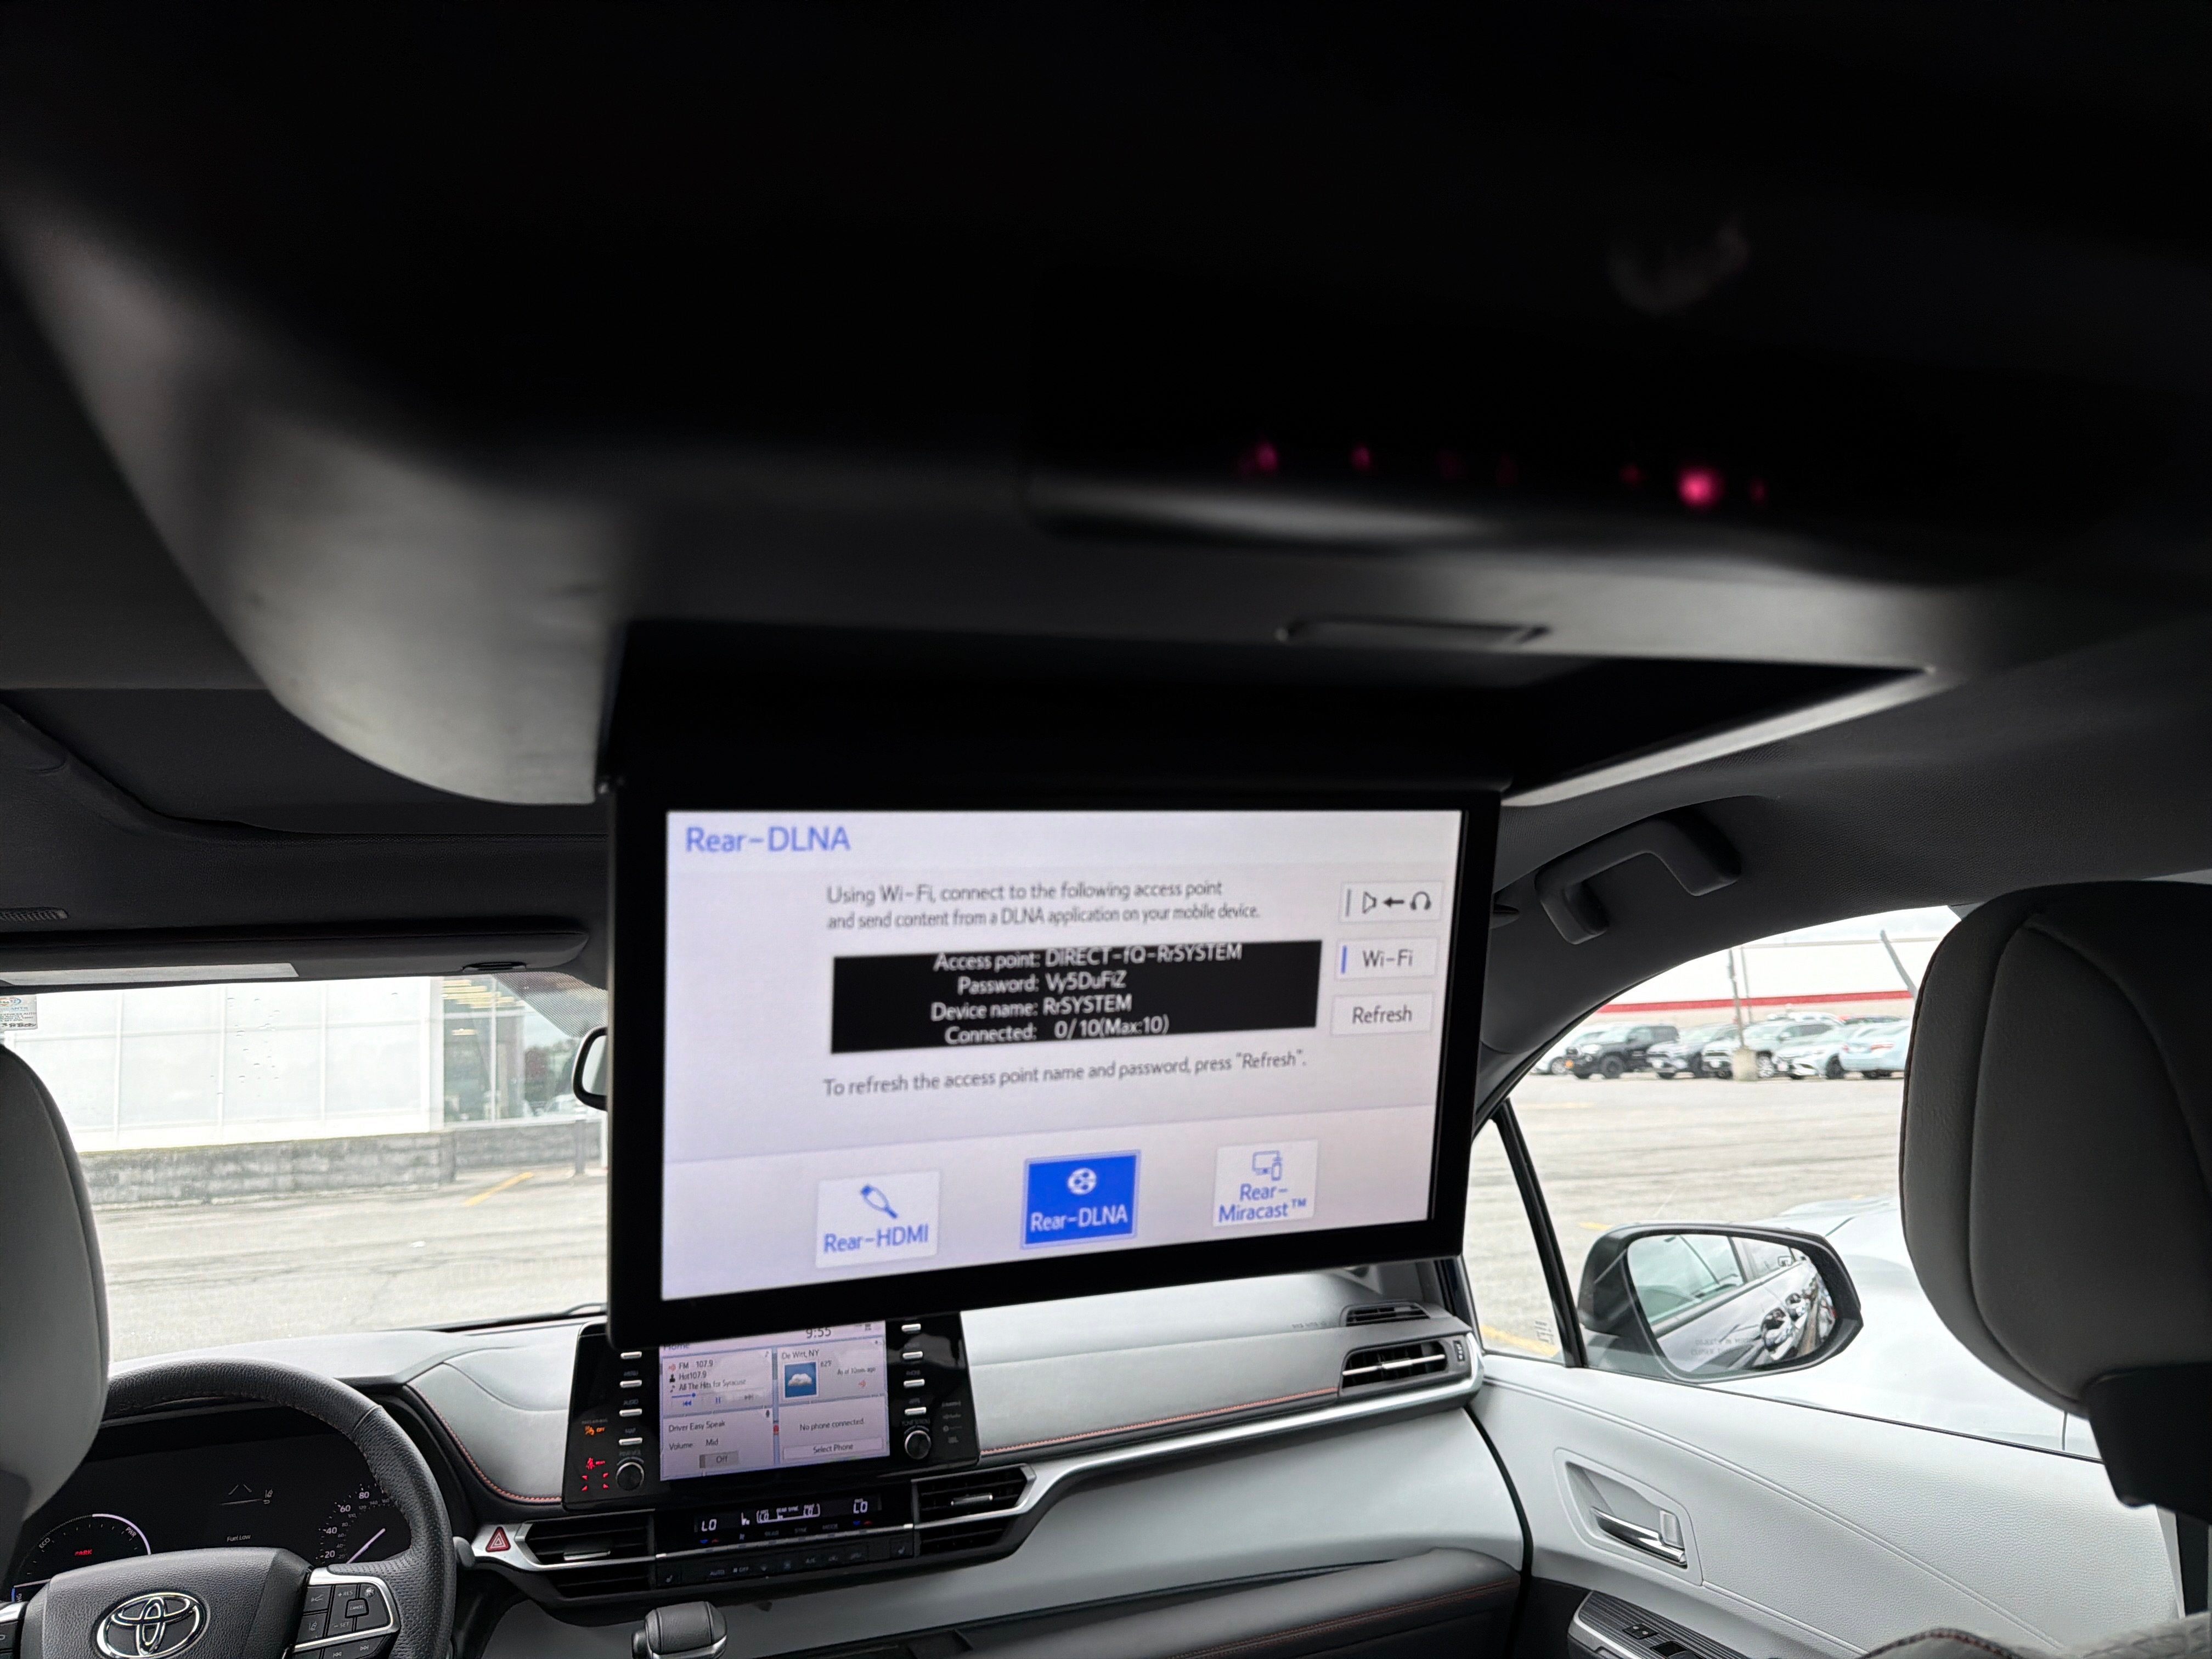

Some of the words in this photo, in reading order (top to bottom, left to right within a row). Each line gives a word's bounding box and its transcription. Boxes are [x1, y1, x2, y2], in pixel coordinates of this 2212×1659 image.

[686, 826, 851, 852] Rear-DLNA
[827, 885, 876, 906] Using
[880, 883, 936, 903] Wi-Fi,
[940, 885, 1004, 901] connect
[1009, 885, 1027, 900] to
[1030, 881, 1056, 899] the
[1060, 881, 1131, 901] following
[1134, 883, 1182, 897] access
[1185, 880, 1222, 900] point
[828, 911, 855, 929] and
[858, 910, 893, 929] send
[894, 911, 949, 928] content
[952, 908, 987, 926] from
[989, 912, 998, 926] a
[1000, 906, 1044, 925] DLNA
[1048, 906, 1120, 926] application
[1122, 909, 1139, 922] on
[1142, 908, 1170, 924] your
[1172, 902, 1216, 920] mobile
[1217, 901, 1260, 919] device.
[933, 952, 992, 972] Access
[994, 951, 1040, 973] point:
[1362, 948, 1413, 967] Wi-Fi
[957, 973, 1040, 995] Password:
[930, 1002, 987, 1022] Device
[990, 1002, 1039, 1019] name:
[1042, 993, 1132, 1016] RrSYSTEM
[1352, 1003, 1413, 1024] Refresh
[944, 1022, 1037, 1045] Connected:
[823, 1078, 845, 1096] To
[848, 1074, 909, 1096] refresh
[913, 1073, 941, 1091] the
[944, 1071, 996, 1088] access
[999, 1066, 1039, 1088] point
[1043, 1066, 1085, 1082] name
[1087, 1060, 1116, 1079] and
[1119, 1056, 1191, 1080] password,
[1194, 1058, 1232, 1076] press
[1239, 1183, 1288, 1201] Rear-
[1030, 1204, 1128, 1233] Rear-DLNA
[823, 1223, 929, 1253] Rear-HDMI
[806, 1327, 831, 1339] 9:55
[696, 1359, 713, 1368] 107.9
[679, 1370, 707, 1380] Hot107.9
[723, 1379, 746, 1387] Syracuse
[669, 1424, 688, 1432] Driver
[690, 1422, 704, 1430] Easy
[706, 1420, 725, 1428] Speak
[811, 1422, 830, 1431] phone
[832, 1418, 864, 1427] connected
[669, 1442, 693, 1451] Volume
[813, 1446, 832, 1454] Select
[833, 1443, 853, 1452] Phone
[716, 1455, 728, 1463] Off
[125, 1526, 137, 1537] PWR
[701, 1519, 717, 1532] LO
[38, 1537, 50, 1549] ECO
[325, 1550, 335, 1559] 20
